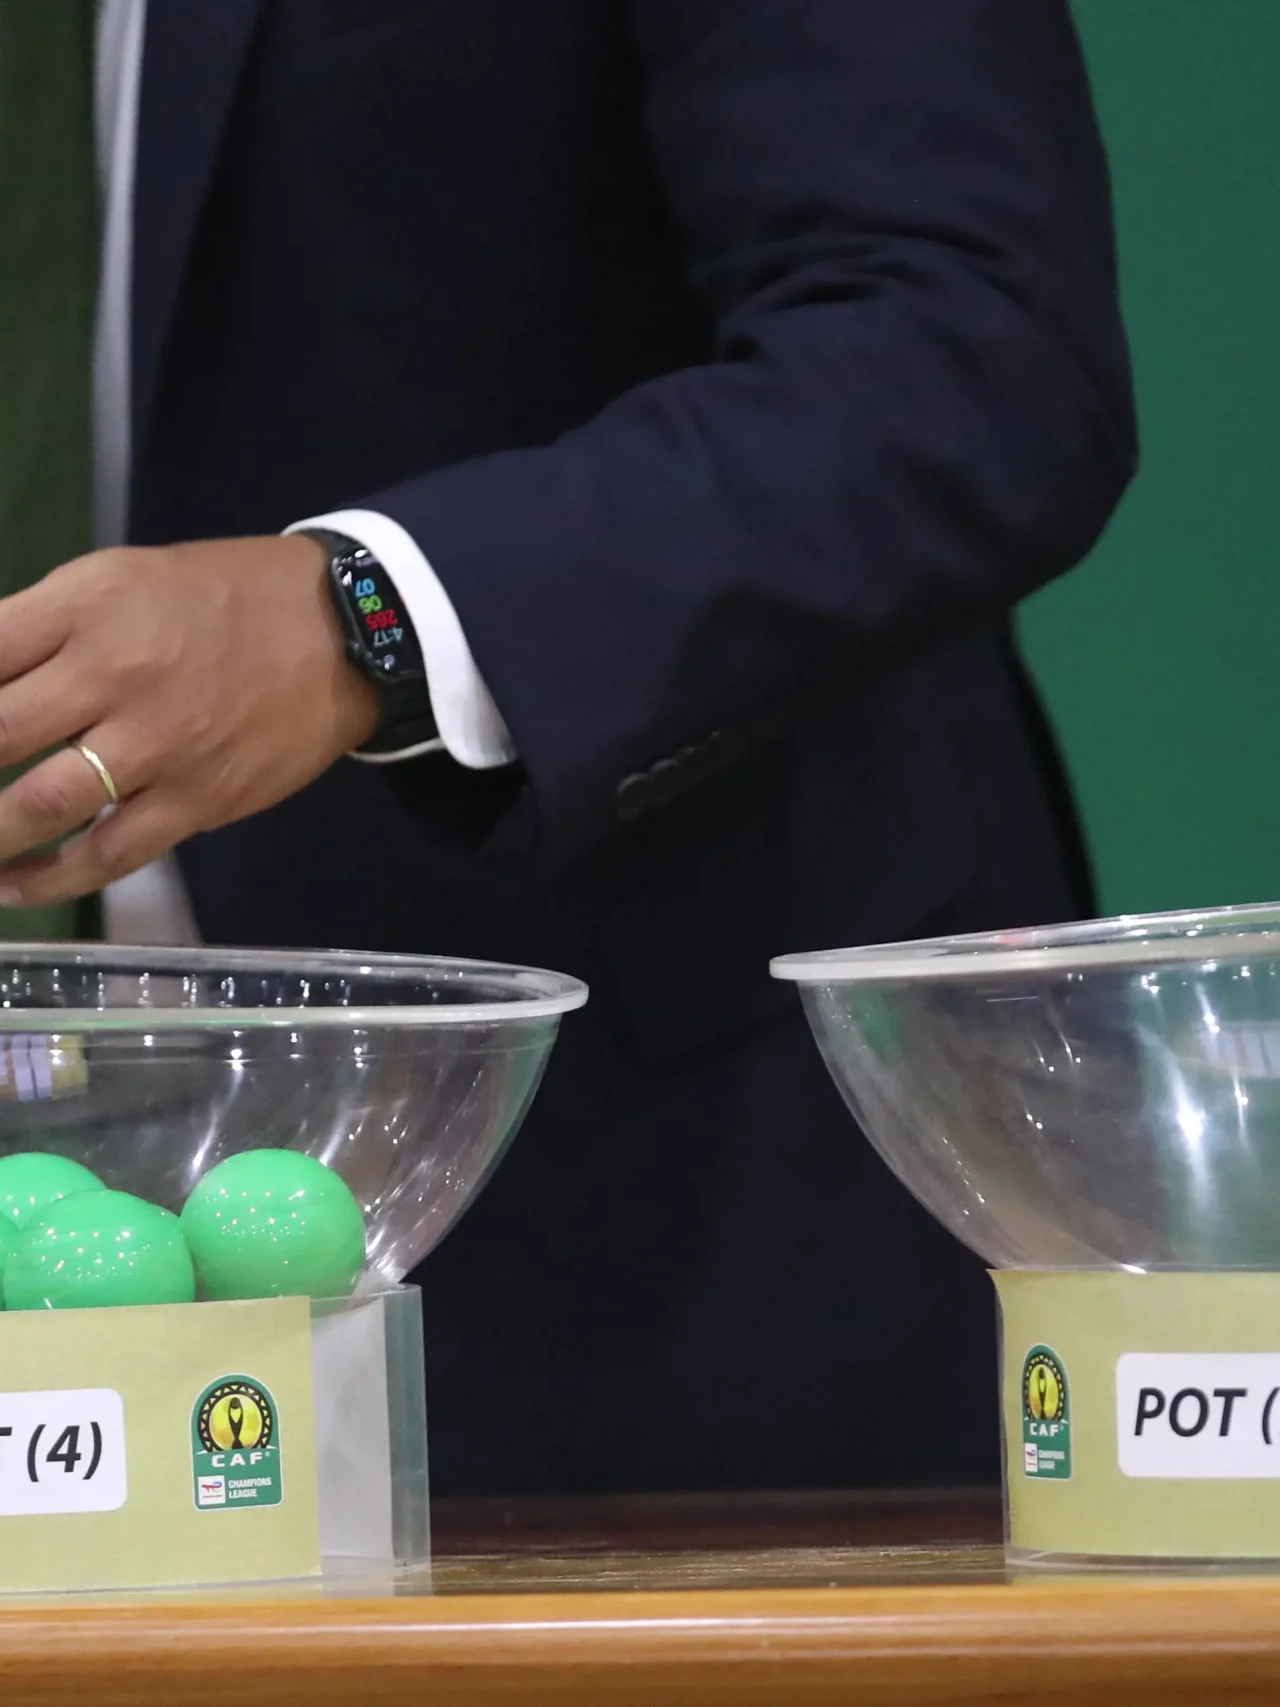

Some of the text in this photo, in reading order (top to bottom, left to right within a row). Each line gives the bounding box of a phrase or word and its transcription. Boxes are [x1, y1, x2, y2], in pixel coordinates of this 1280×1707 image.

[356, 578, 375, 597] 07
[1134, 1387, 1248, 1437] POT
[1030, 1422, 1059, 1437] CAF
[27, 1422, 102, 1482] (4)
[211, 1451, 263, 1468] CAF
[228, 1477, 272, 1489] CHAMPIONS
[228, 1488, 257, 1499] LEAGUE
